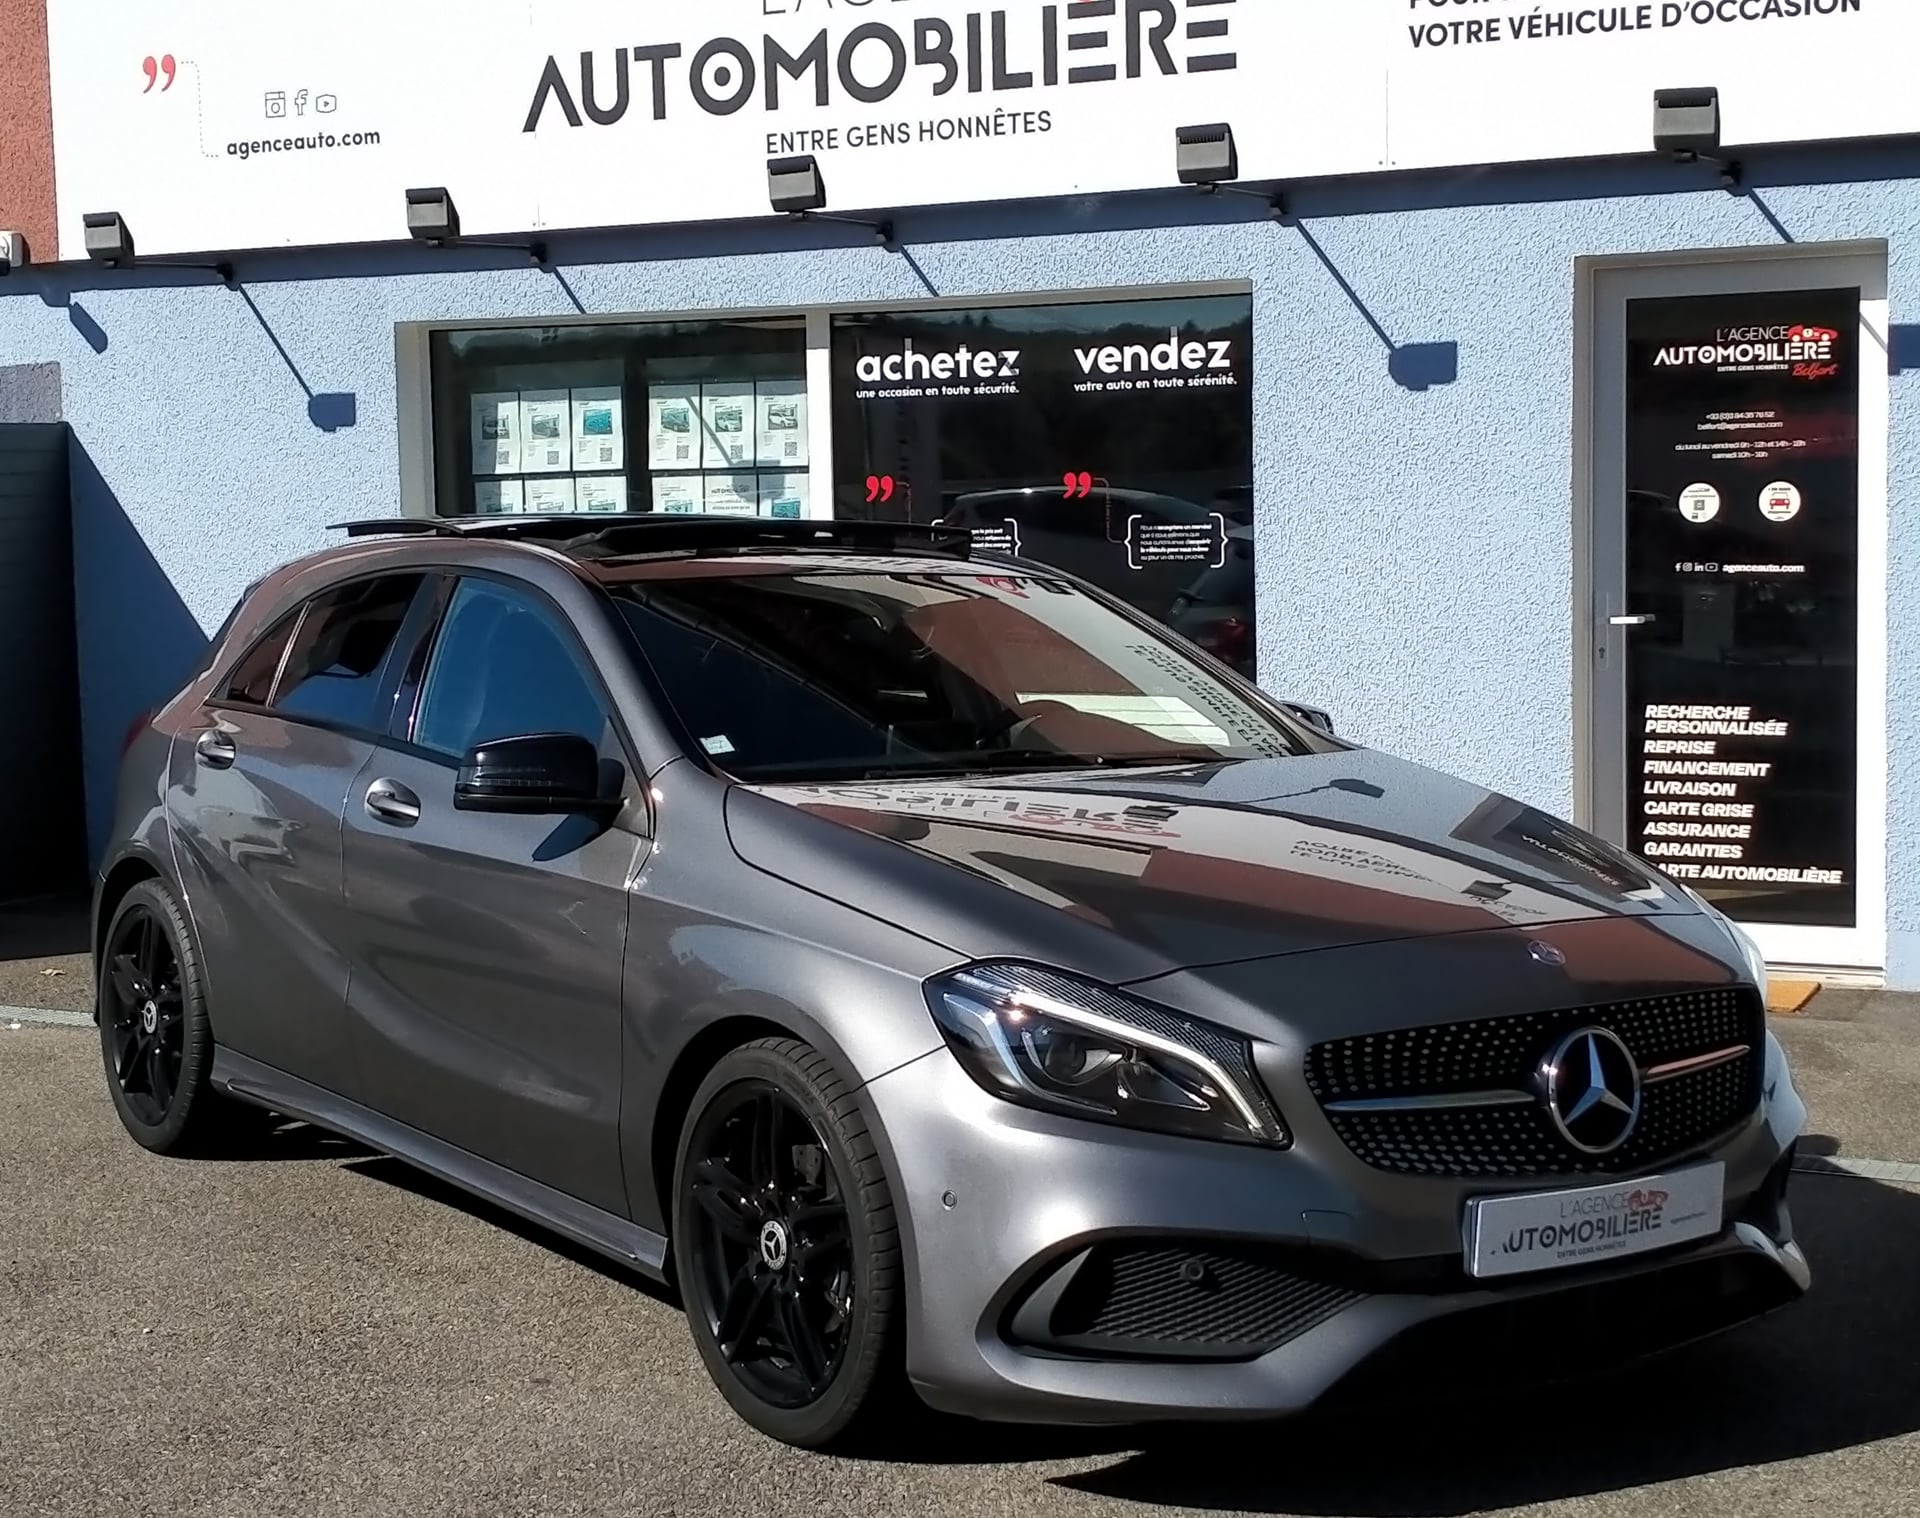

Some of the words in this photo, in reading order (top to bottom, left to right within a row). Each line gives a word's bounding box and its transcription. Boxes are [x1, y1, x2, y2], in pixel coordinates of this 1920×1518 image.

[1409, 18, 1501, 48] VOTRE
[1508, 5, 1652, 39] VÉHICULE
[766, 128, 839, 154] ENTRE
[847, 122, 911, 148] GENS
[919, 107, 1052, 142] HONNÊTES
[227, 130, 381, 160] agenceauto.com
[1717, 326, 1789, 342] L'AGENCE
[1073, 326, 1231, 374] vendez
[856, 338, 1020, 382] achetez
[1073, 381, 1103, 393] votre
[1106, 379, 1133, 391] auto
[1136, 380, 1150, 389] en
[1152, 377, 1184, 388] toute
[1187, 372, 1238, 387] sérénité.
[856, 389, 876, 399] une
[878, 385, 923, 398] occasion
[925, 387, 939, 396] en
[942, 385, 971, 396] toute
[1644, 704, 1751, 720] RECHERCHE
[1644, 718, 1788, 736] PERSONNALISÉE
[1643, 739, 1716, 755] REPRISE
[1643, 759, 1771, 777] FINANCEMENT
[1643, 780, 1737, 797] LIVRAISON
[1643, 800, 1701, 816] CARTE
[1702, 802, 1754, 818] GRISE
[1643, 821, 1751, 838] ASSURANCE
[1643, 841, 1743, 859] GARANTIES
[1654, 863, 1701, 879] ARTE
[1701, 864, 1843, 884] AUTOMOBILIÈRE
[1560, 1191, 1629, 1218] L'AGENCE
